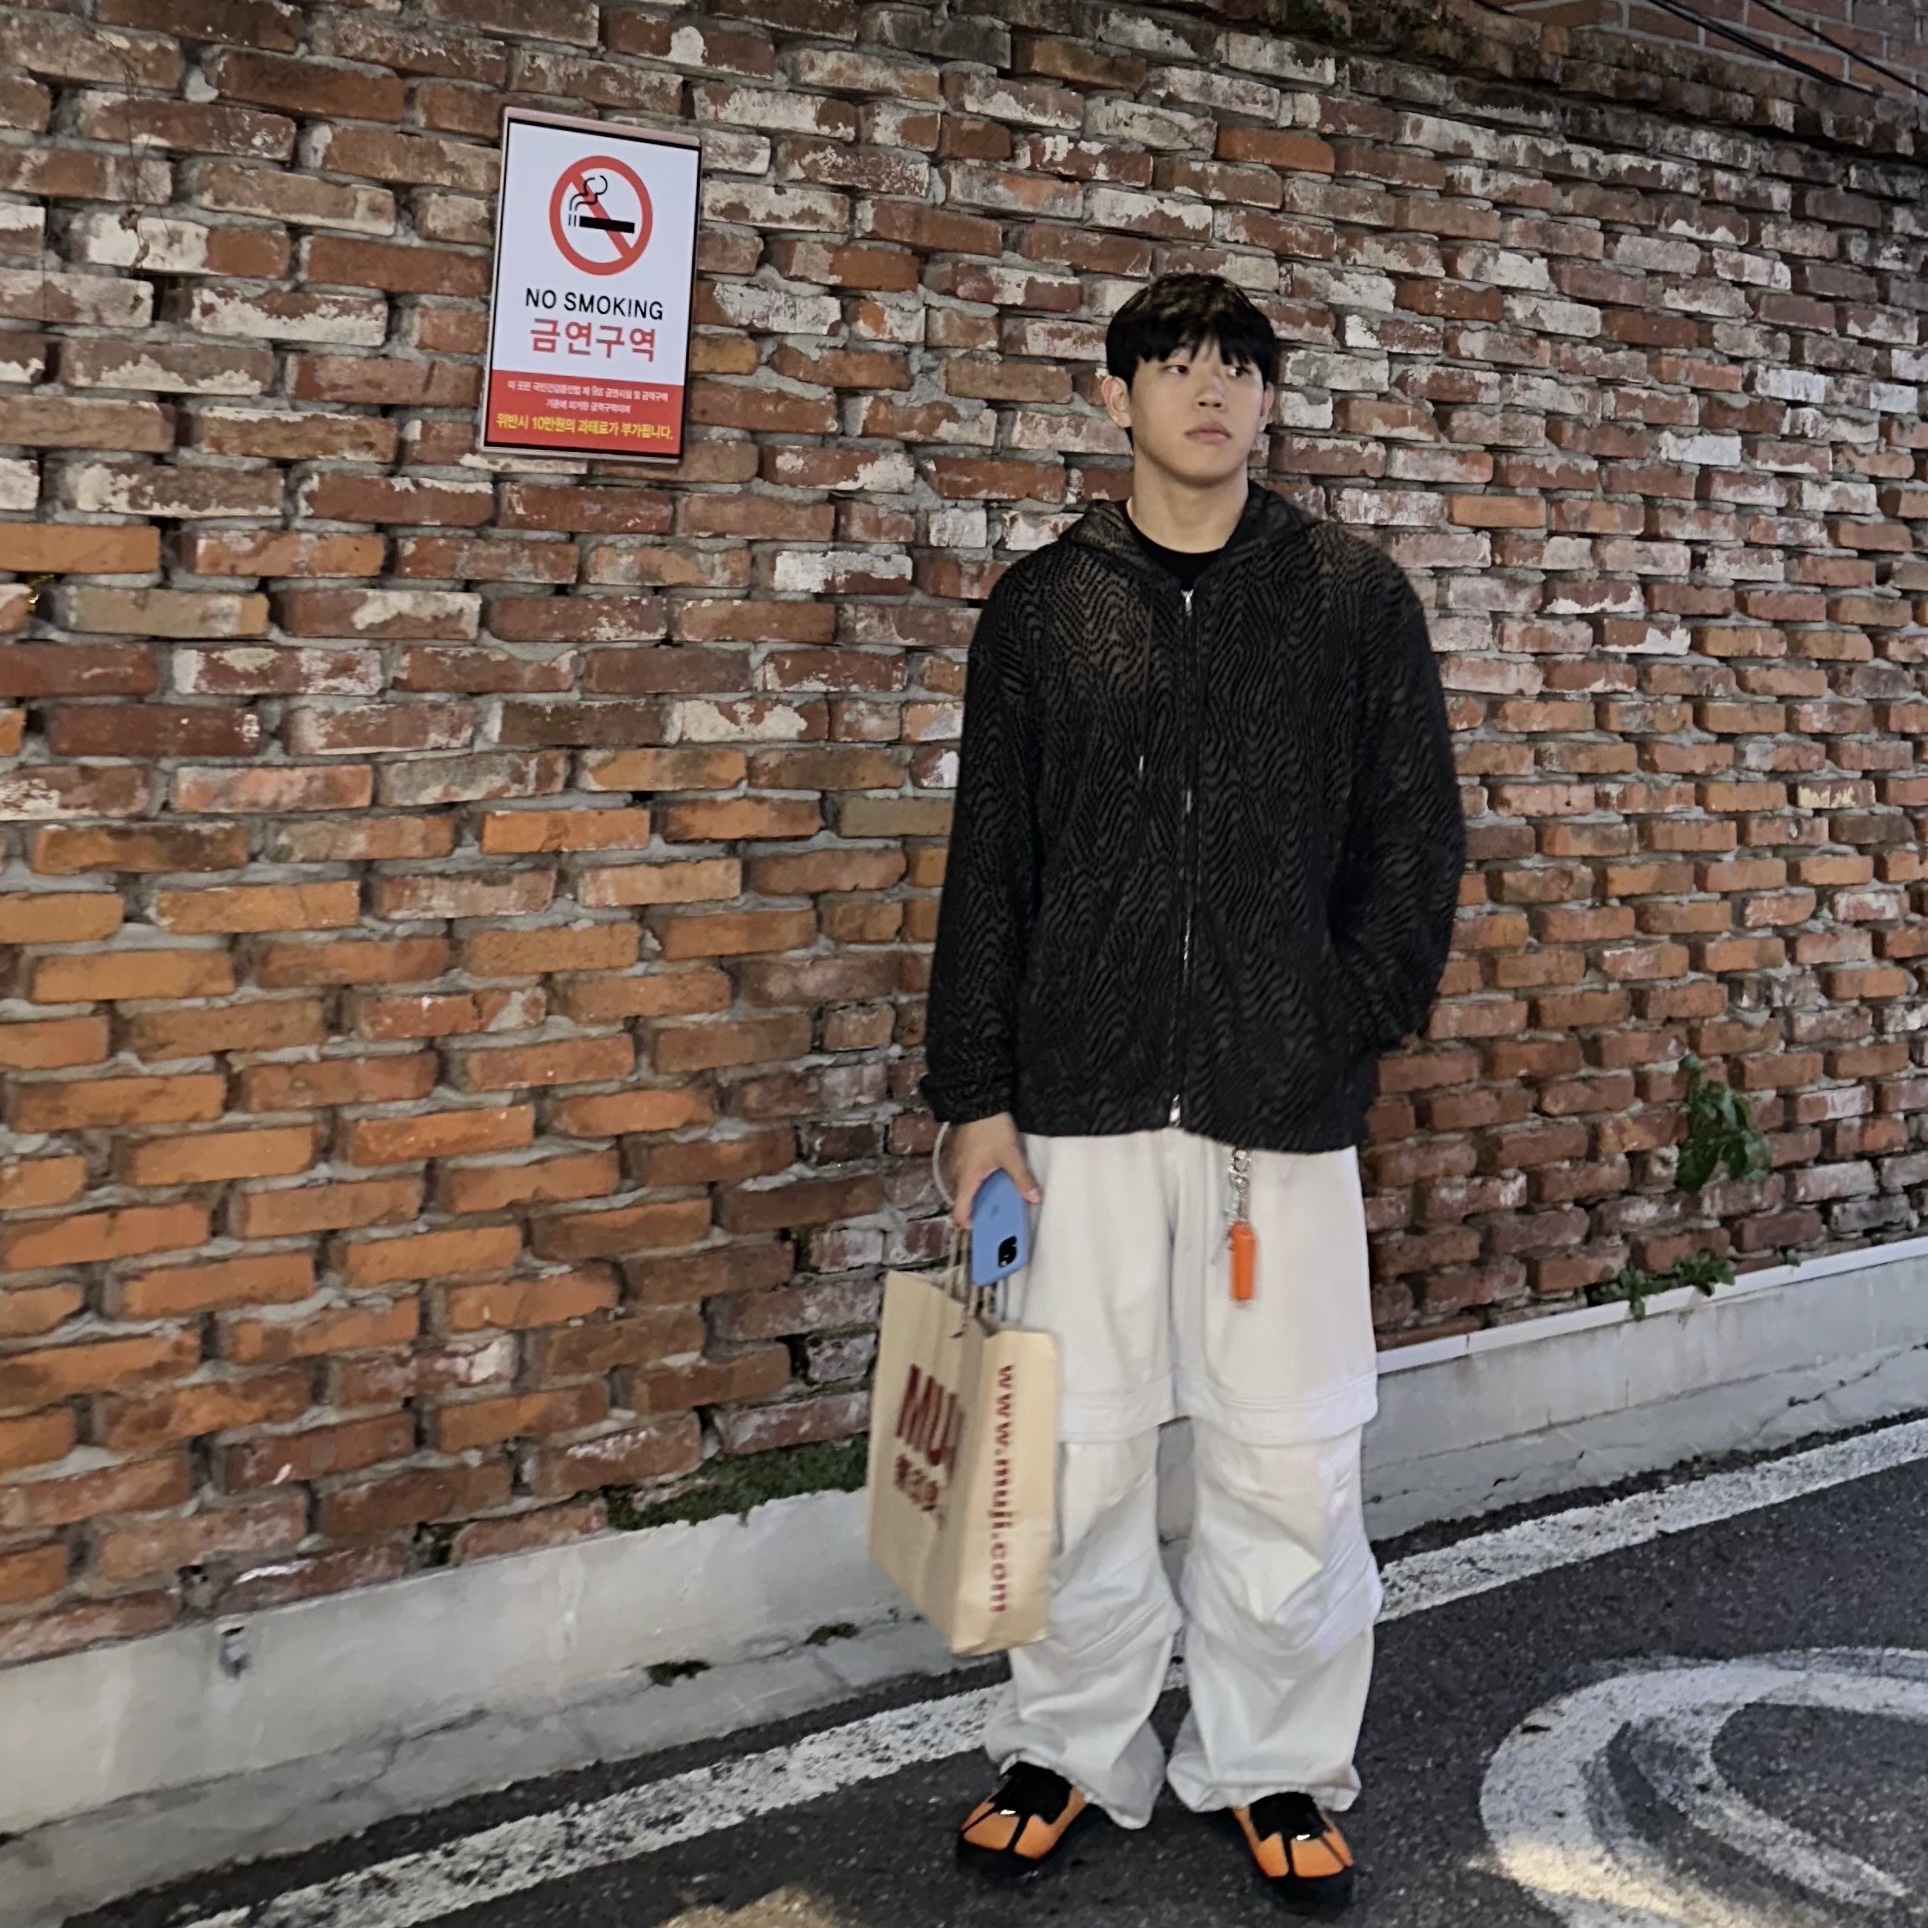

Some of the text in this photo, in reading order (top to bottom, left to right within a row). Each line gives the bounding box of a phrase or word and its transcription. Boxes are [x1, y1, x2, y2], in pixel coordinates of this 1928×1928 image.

[525, 287, 663, 320] NO SMOKING
[530, 317, 656, 362] 금연구역
[496, 412, 529, 430] 위반시
[531, 415, 575, 434] 10만원의
[578, 419, 619, 437] 과태료가
[988, 1363, 1016, 1613] www.muji.com
